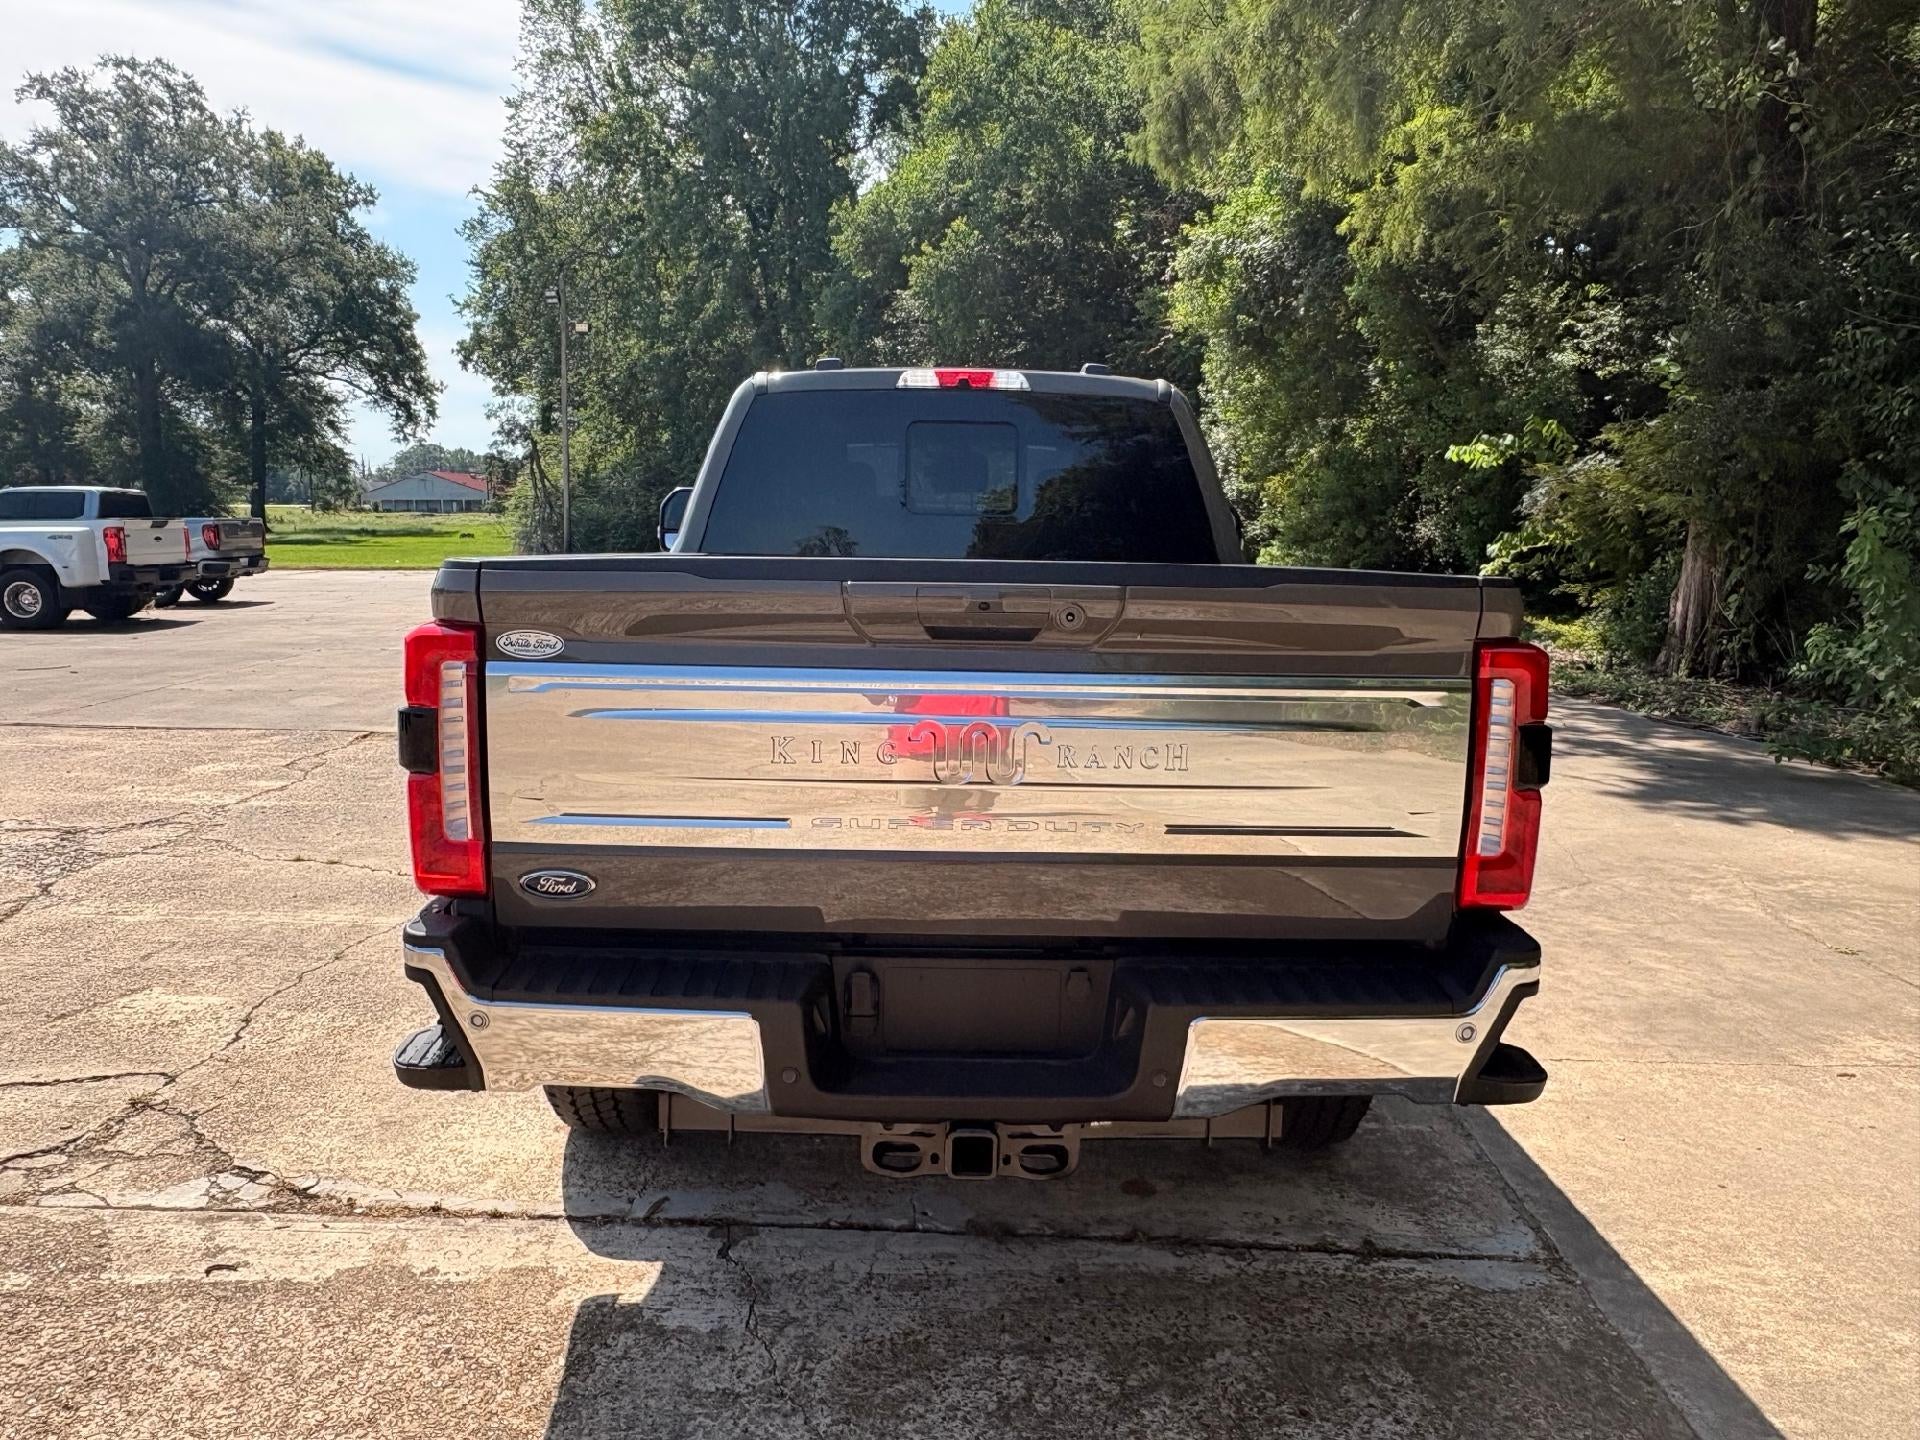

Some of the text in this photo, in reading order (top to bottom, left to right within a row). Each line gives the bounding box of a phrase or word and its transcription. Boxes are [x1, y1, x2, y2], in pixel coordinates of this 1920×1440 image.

[533, 639, 558, 649] Ford
[770, 736, 1190, 772] KING RANCH
[811, 817, 1145, 834] SUPER DUTY
[537, 876, 577, 893] Ford
